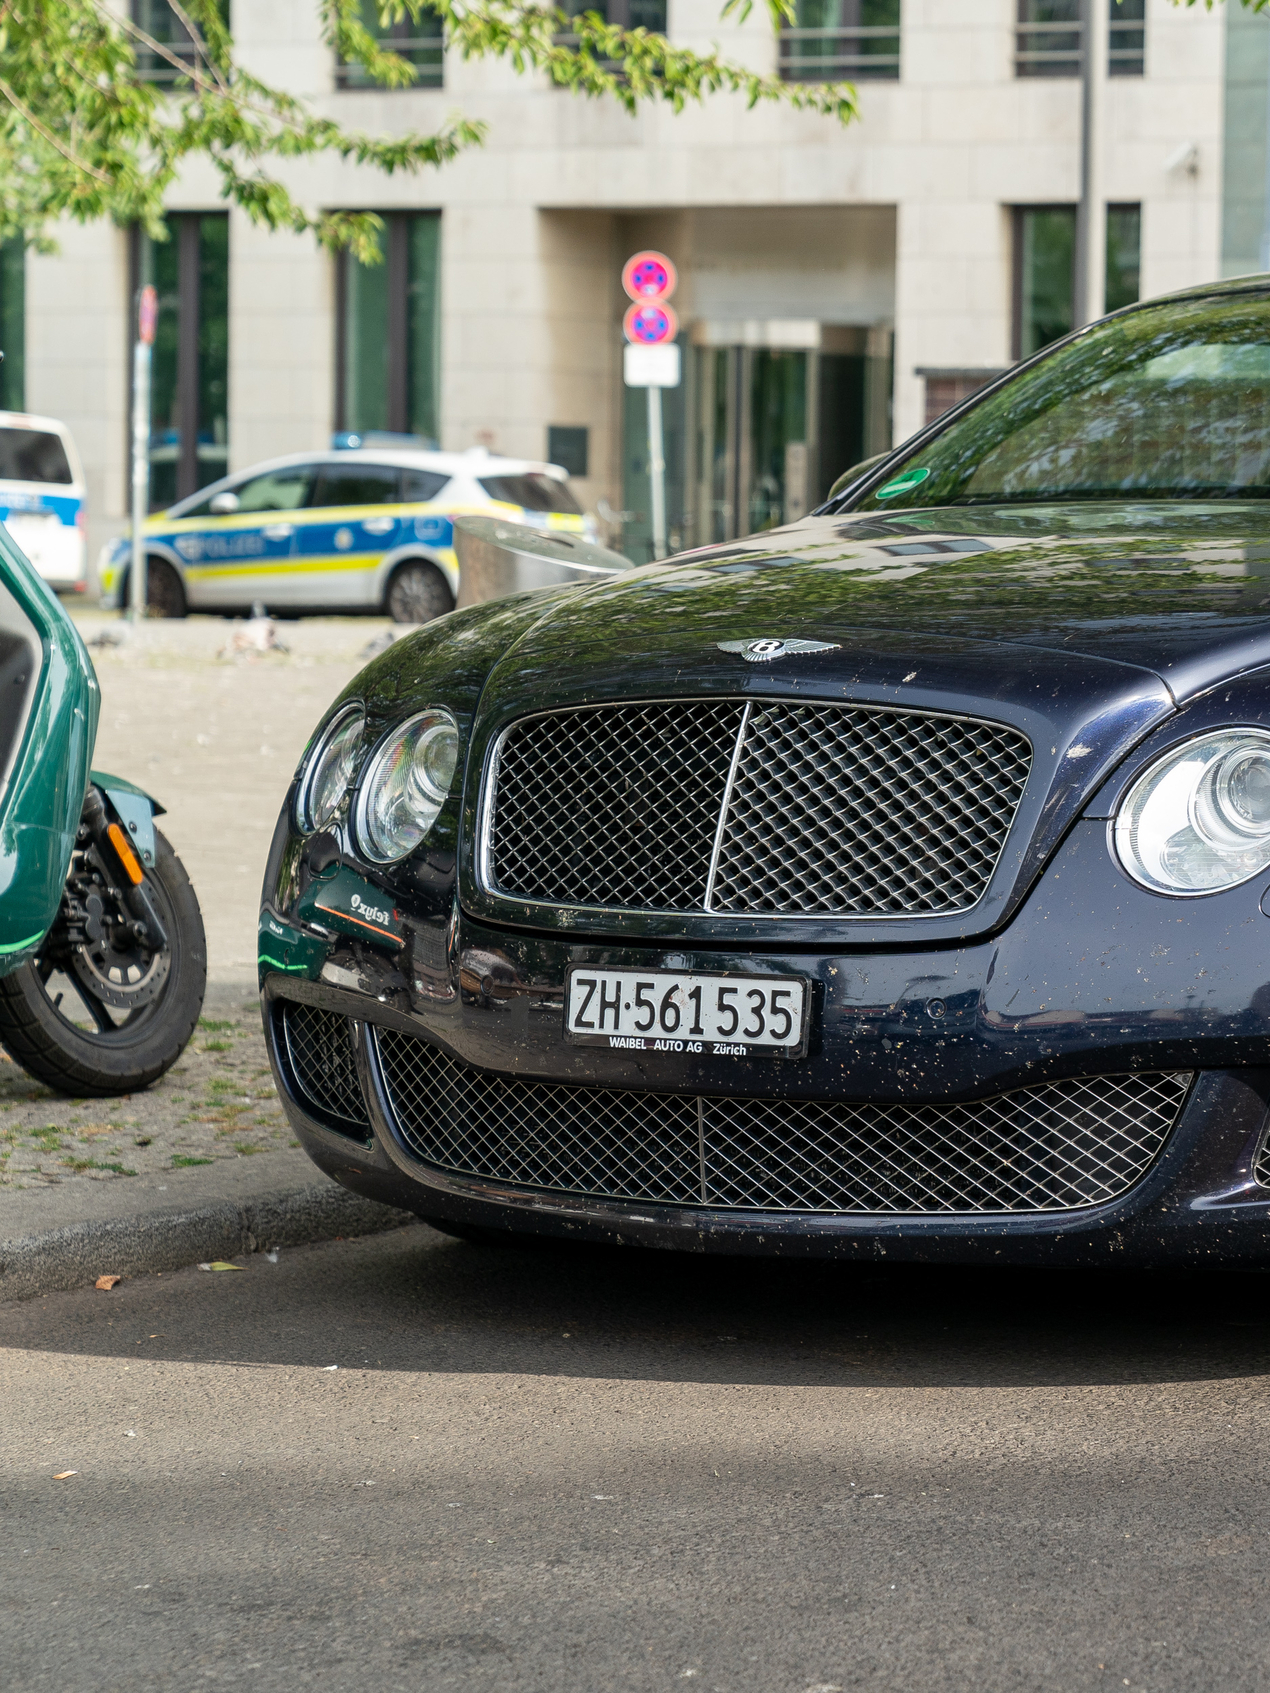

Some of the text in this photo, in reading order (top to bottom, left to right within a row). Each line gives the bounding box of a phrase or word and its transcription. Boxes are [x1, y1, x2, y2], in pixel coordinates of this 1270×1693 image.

[609, 1036, 747, 1056] WAIBEL AUTO AG Zürich
